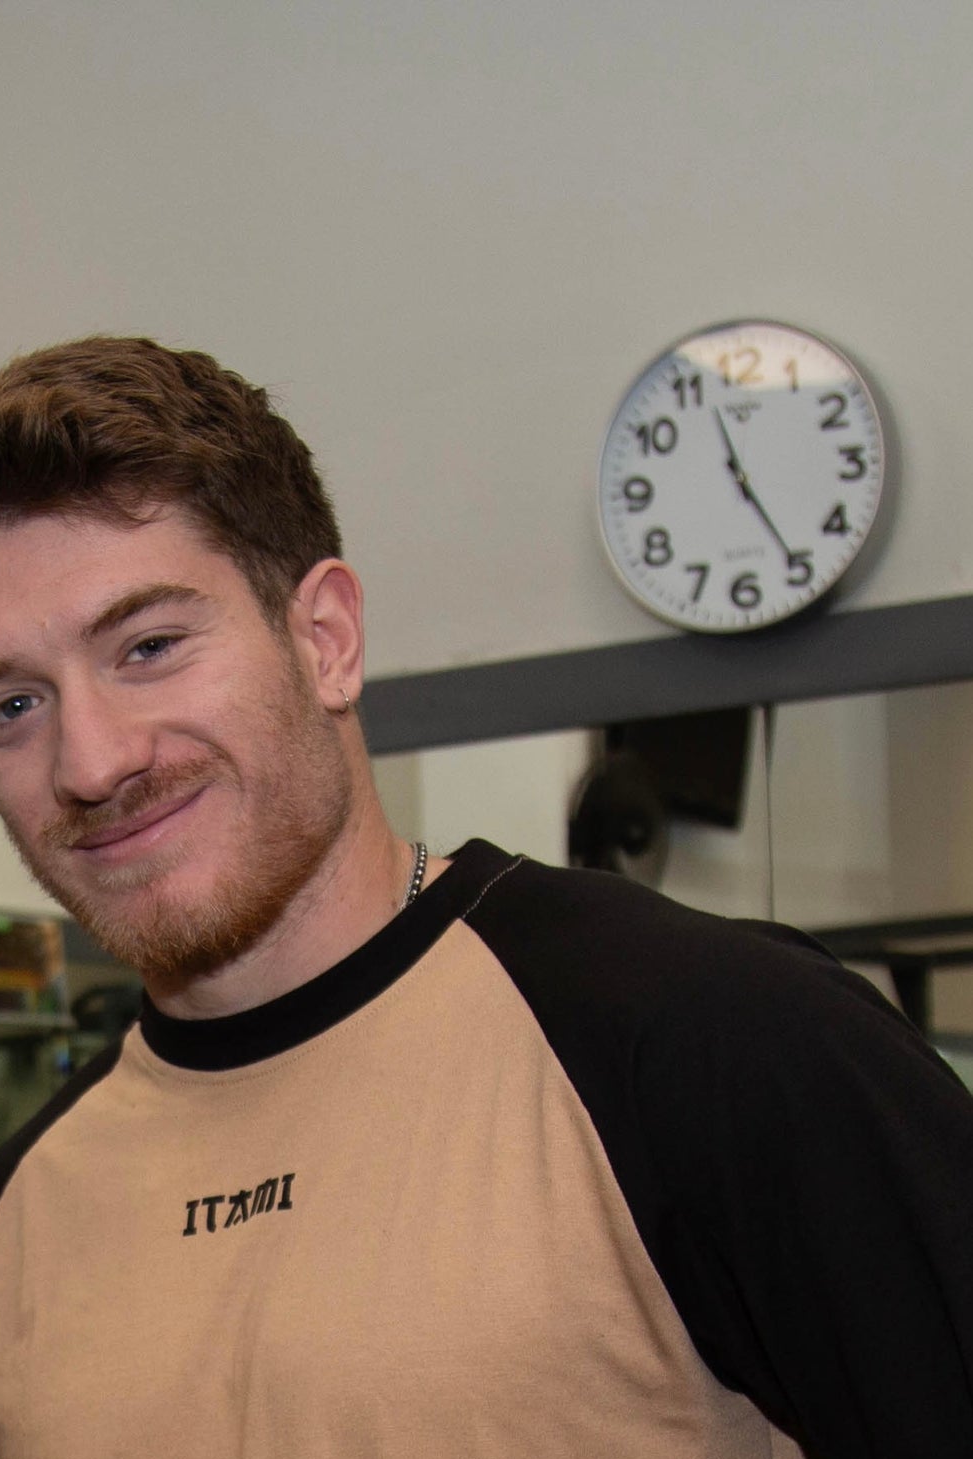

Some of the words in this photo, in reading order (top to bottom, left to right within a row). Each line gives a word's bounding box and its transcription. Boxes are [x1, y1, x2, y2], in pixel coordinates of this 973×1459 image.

[718, 349, 763, 386] 12
[785, 359, 799, 393] 1
[672, 374, 704, 409] 11
[819, 393, 849, 431] 2
[635, 416, 677, 456] 10
[838, 443, 868, 481] 3
[623, 476, 654, 513] 9
[822, 503, 851, 536] 4
[643, 527, 674, 567] 8
[685, 562, 711, 603] 7
[787, 550, 814, 587] 5
[730, 572, 763, 609] 6
[182, 1172, 296, 1237] ITAMI
